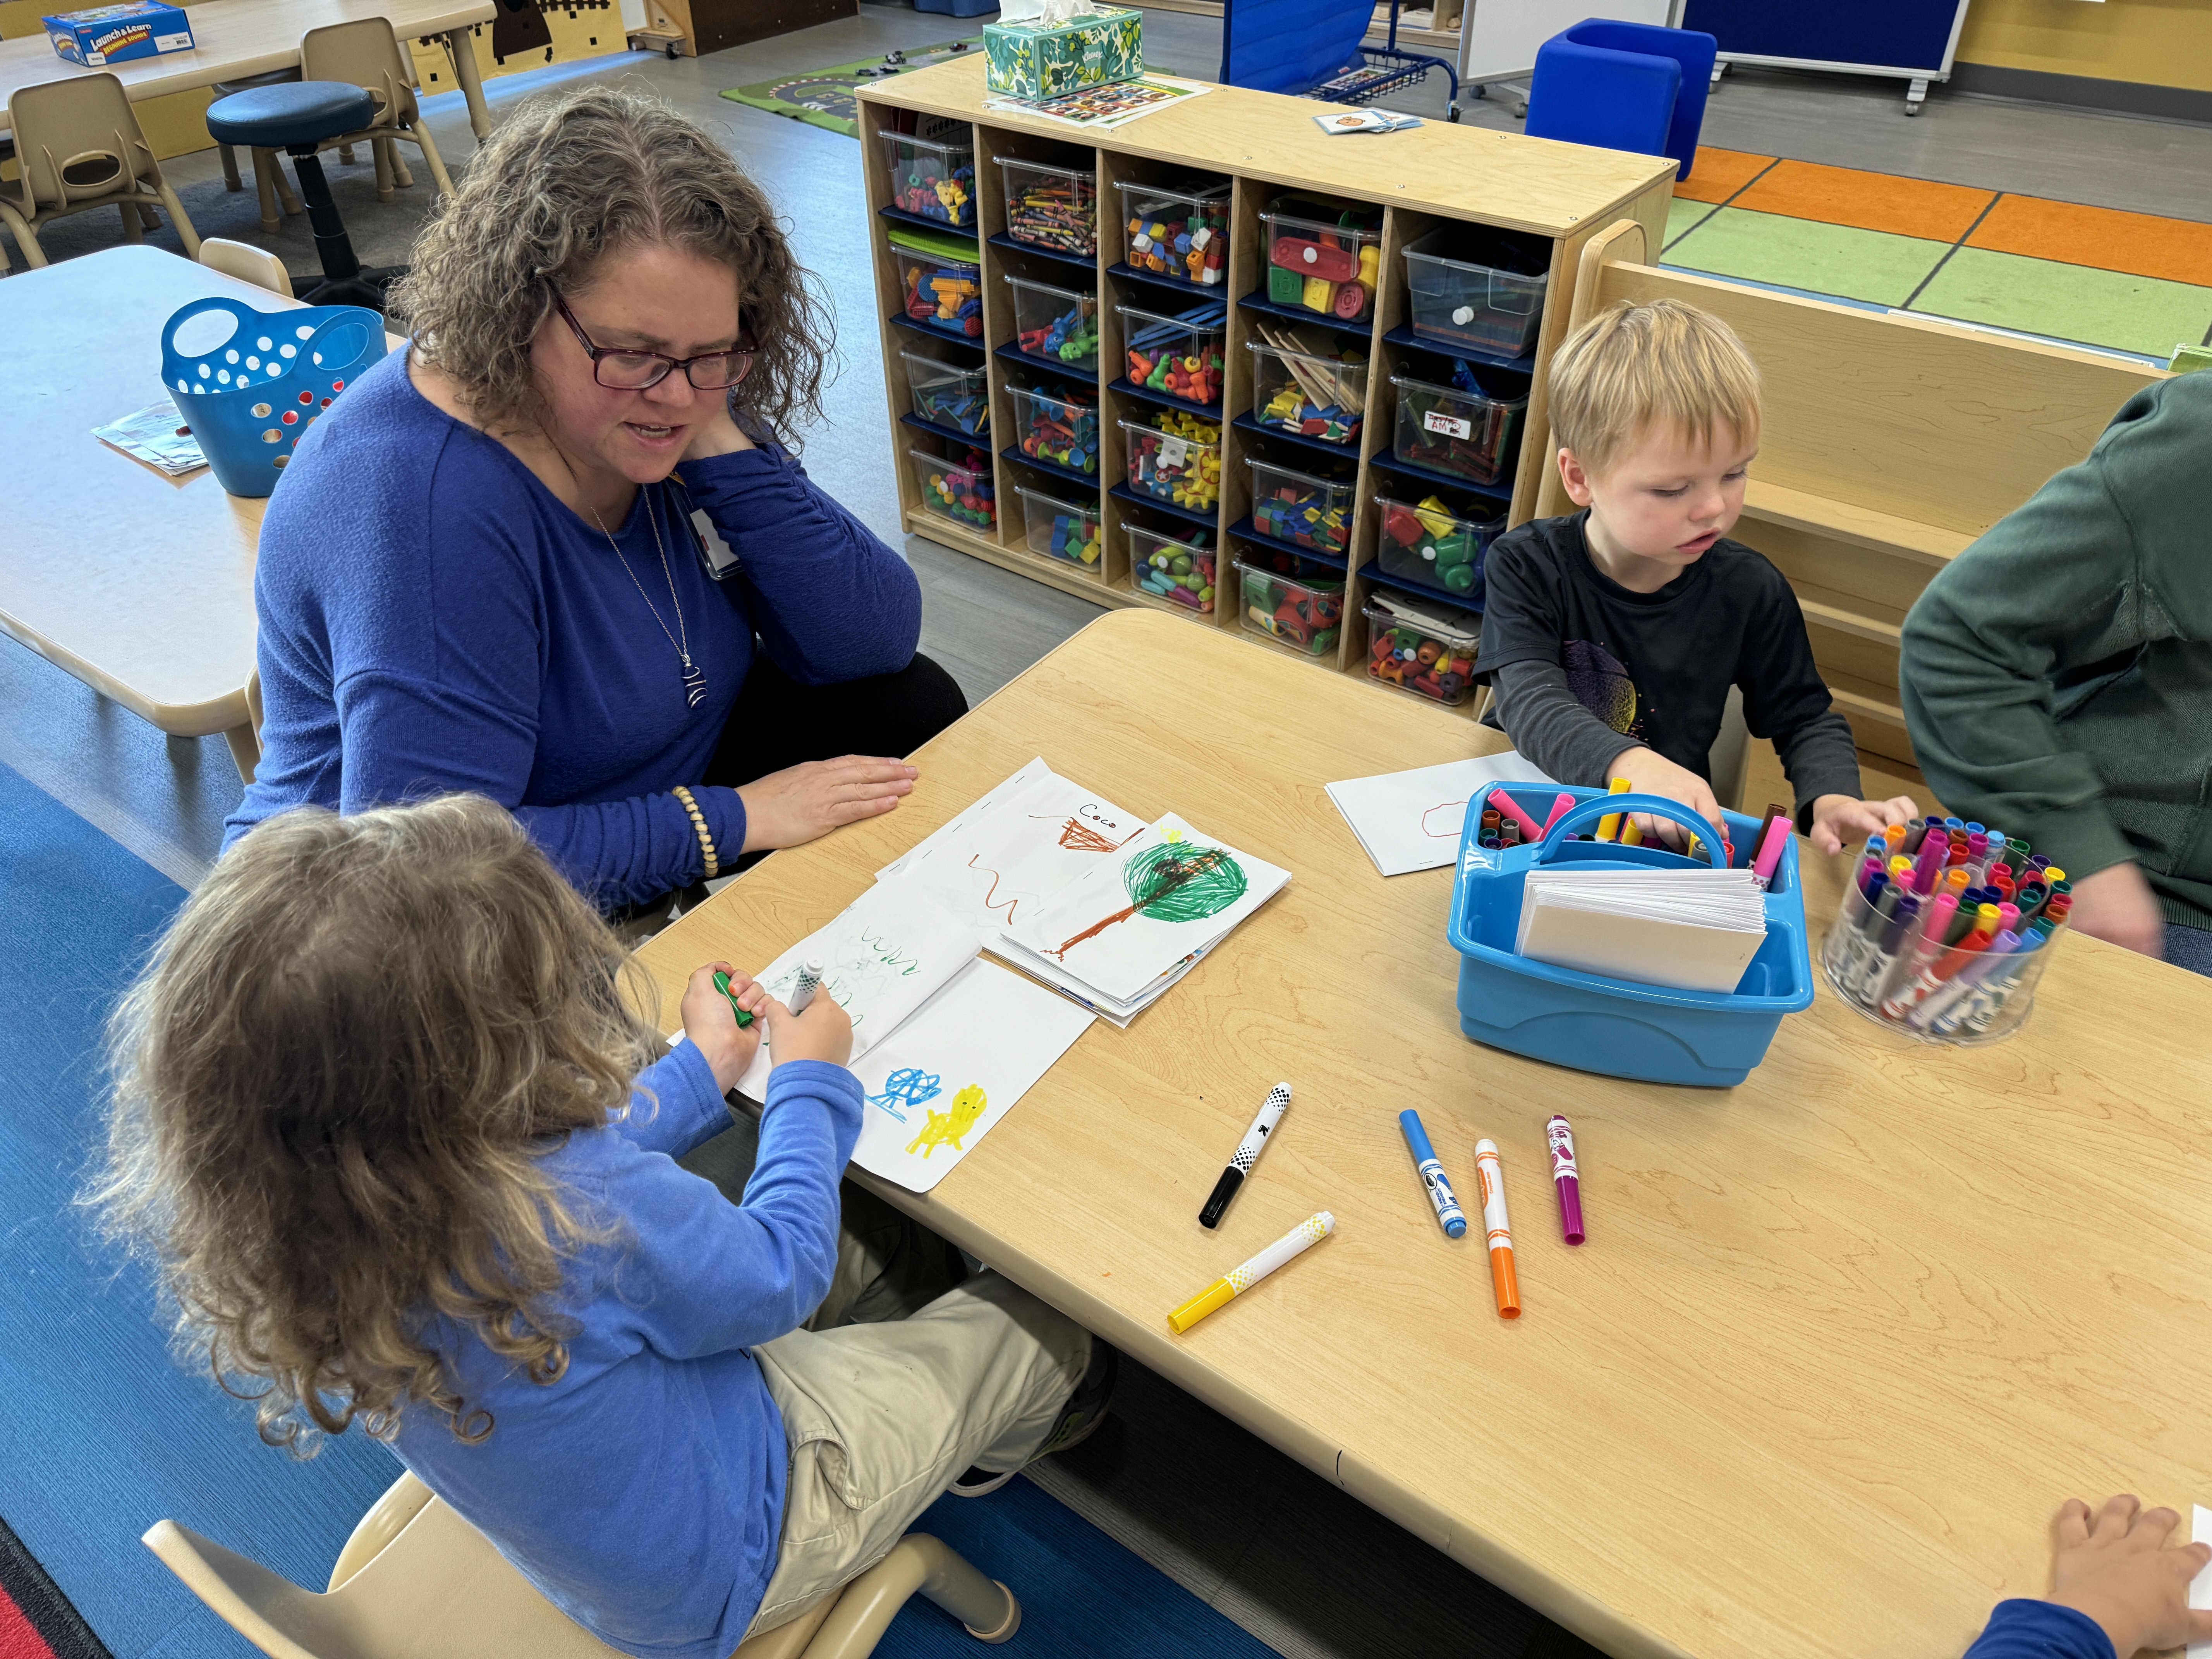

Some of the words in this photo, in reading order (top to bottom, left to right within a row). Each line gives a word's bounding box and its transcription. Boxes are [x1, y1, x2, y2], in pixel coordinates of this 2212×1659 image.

[103, 38, 127, 55] BEGINNING
[127, 32, 147, 42] SOUNDS
[1082, 51, 1103, 63] Kleenex
[1432, 421, 1446, 431] AM
[1080, 804, 1116, 828] Coco
